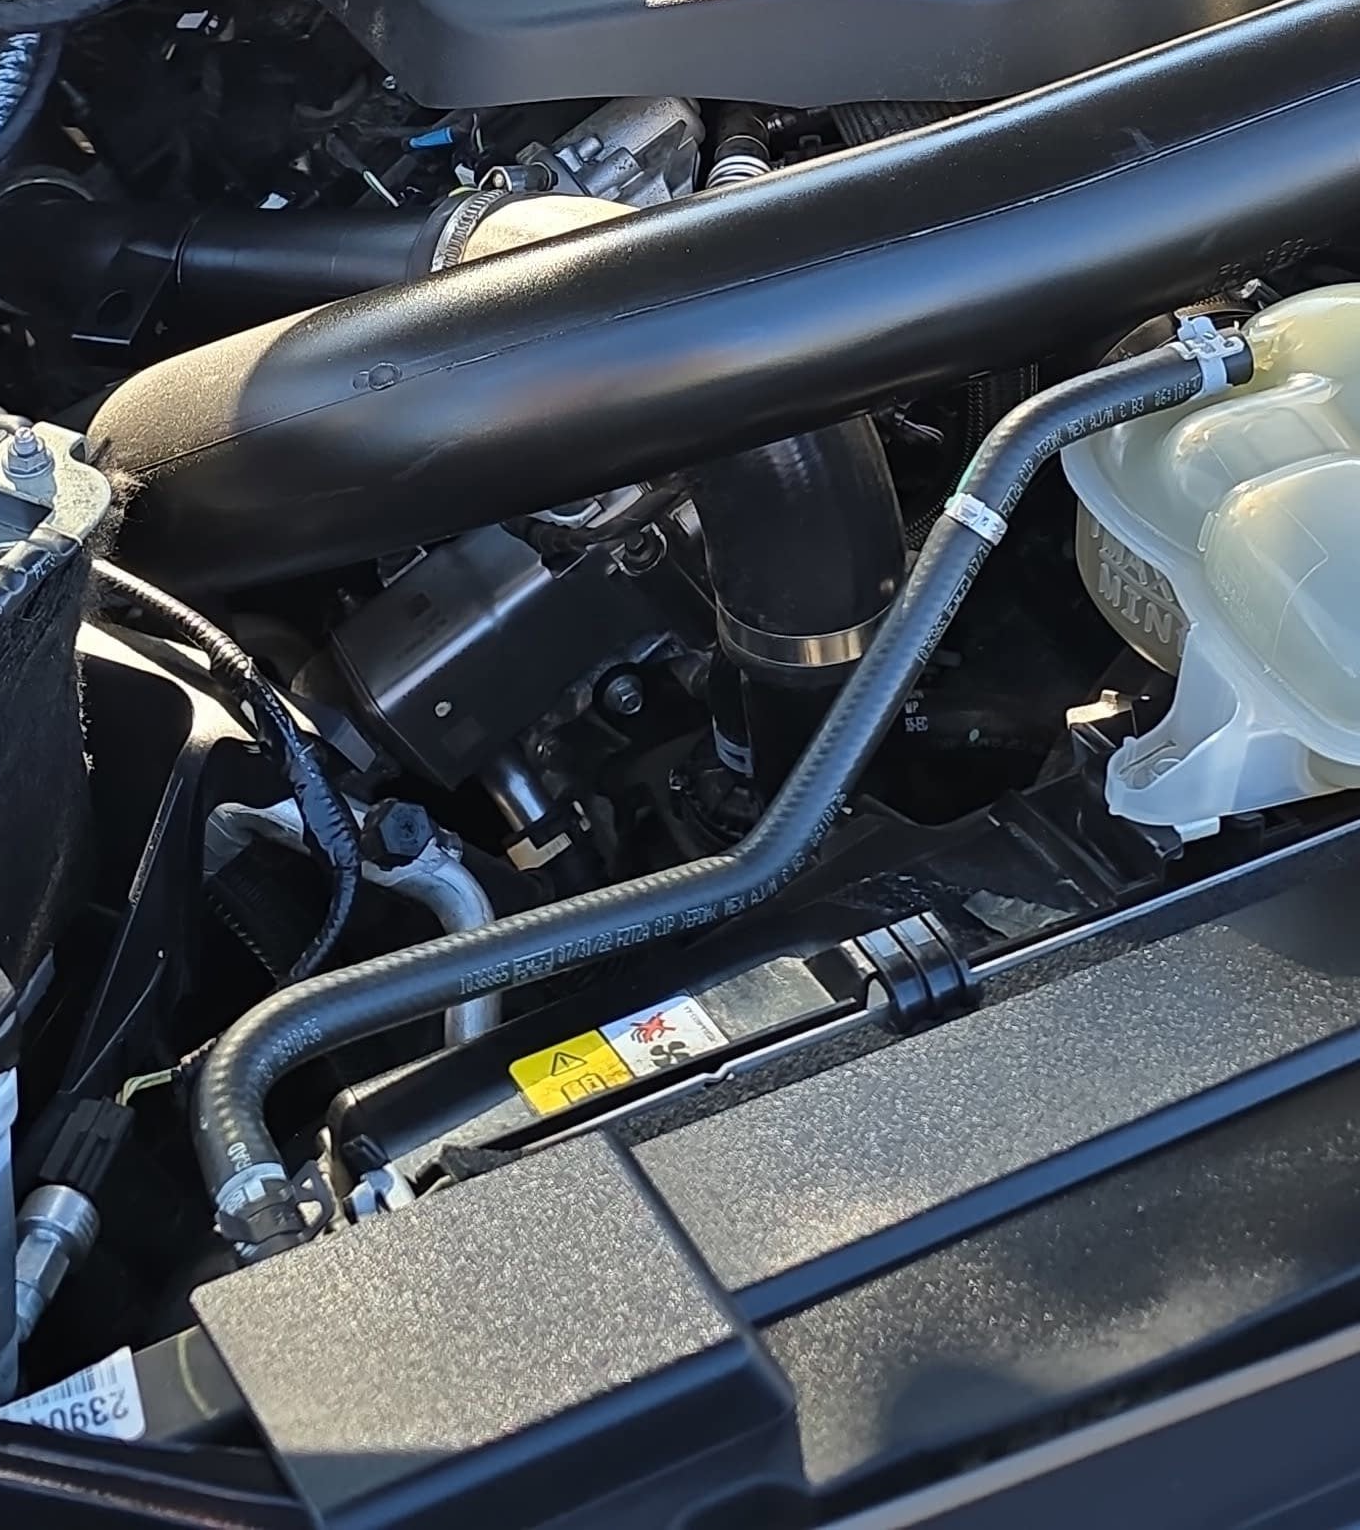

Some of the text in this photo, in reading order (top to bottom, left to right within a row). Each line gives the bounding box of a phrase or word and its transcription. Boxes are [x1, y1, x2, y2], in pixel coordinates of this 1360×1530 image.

[967, 541, 993, 577] 07/31
[1099, 561, 1172, 644] MIN
[31, 1386, 129, 1433] 2390
